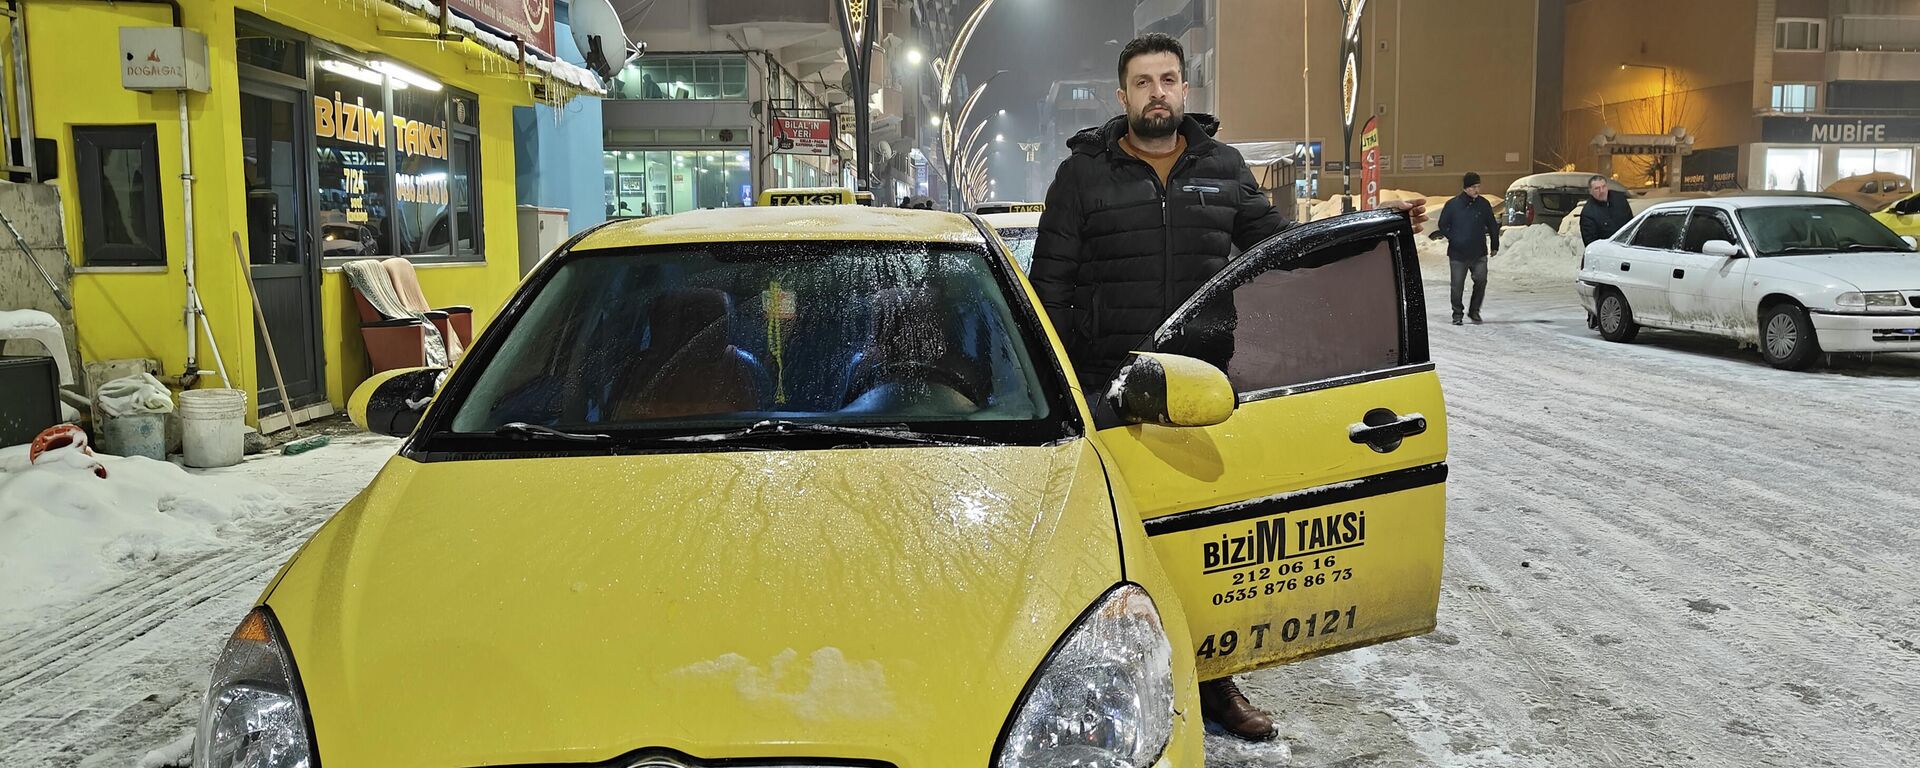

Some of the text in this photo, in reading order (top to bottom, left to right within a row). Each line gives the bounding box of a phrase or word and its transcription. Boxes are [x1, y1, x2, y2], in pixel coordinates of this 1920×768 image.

[314, 91, 386, 148] BİZİM
[1811, 119, 1886, 142] MUBİFE
[343, 168, 365, 195] 7/24
[1212, 567, 1353, 606] 0535 876 86 73
[1232, 555, 1336, 586] 212 06 16
[1196, 605, 1357, 660] 49 T 0121
